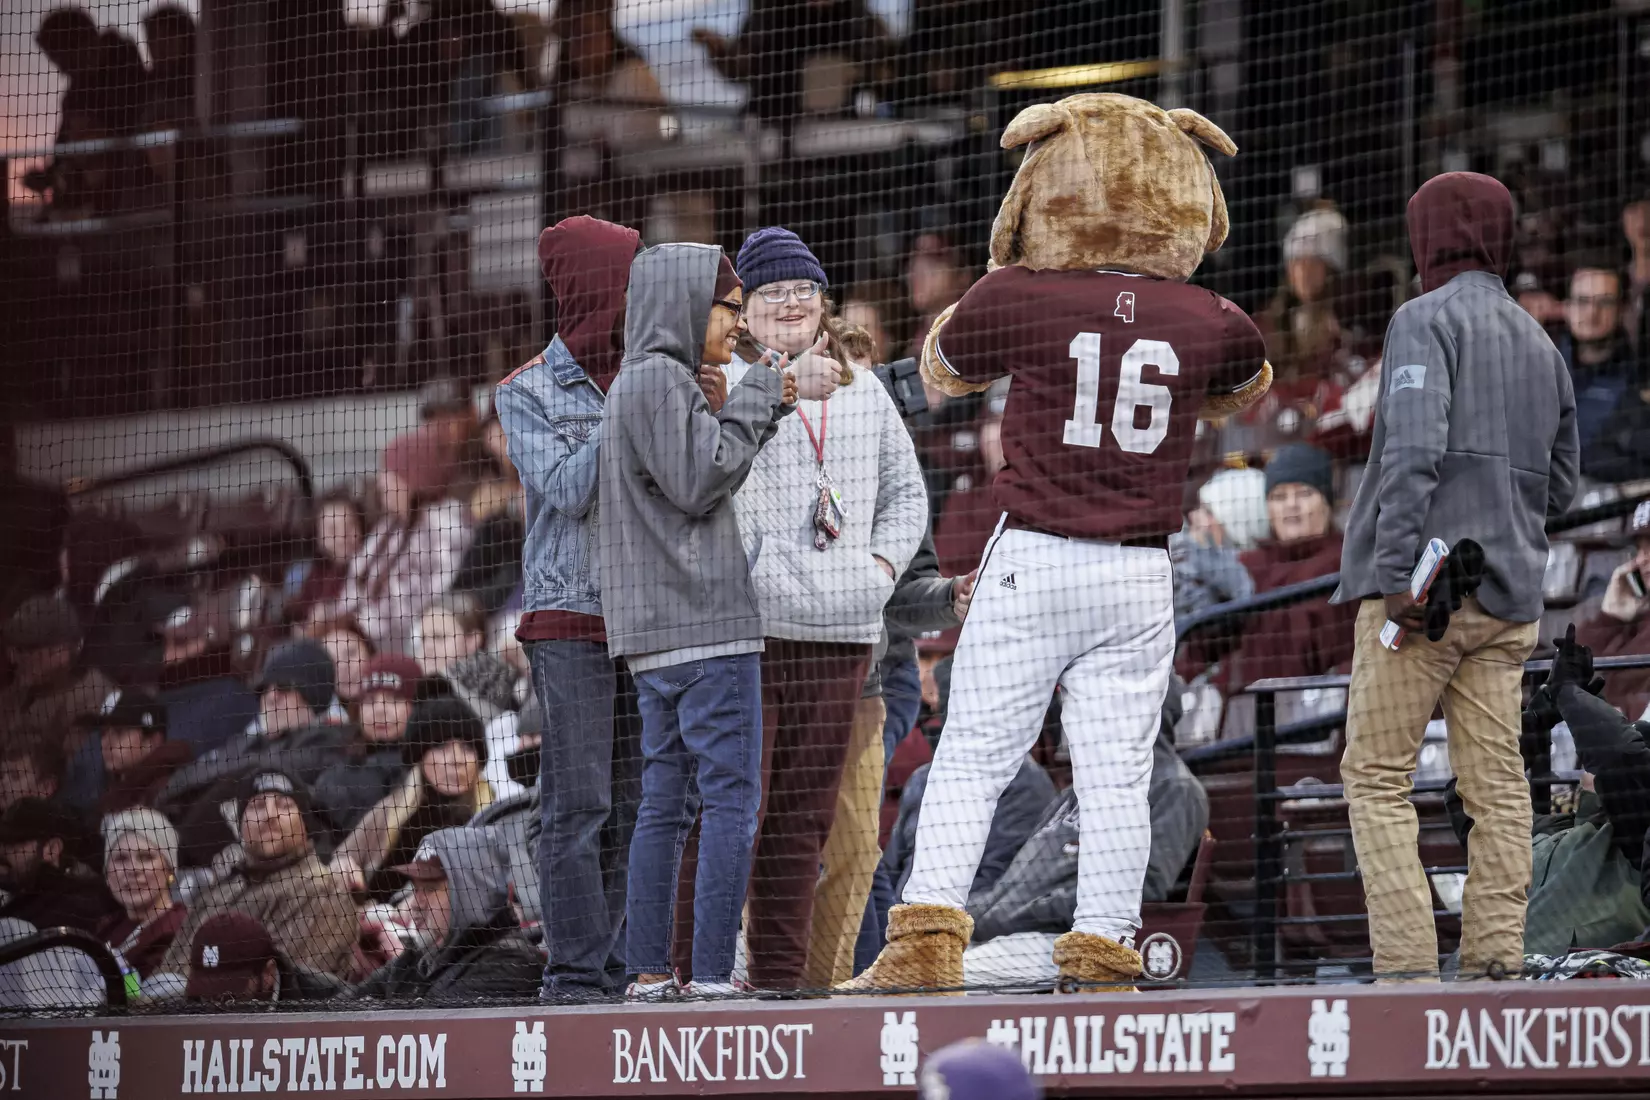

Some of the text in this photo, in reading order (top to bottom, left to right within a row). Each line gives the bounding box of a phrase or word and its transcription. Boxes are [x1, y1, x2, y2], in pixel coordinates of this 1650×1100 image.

[1063, 332, 1180, 455] 16
[182, 1033, 448, 1093] HAILSTATE.COM
[612, 1023, 814, 1084] BANKFIRST
[1424, 1004, 1650, 1069] BANKFIRST
